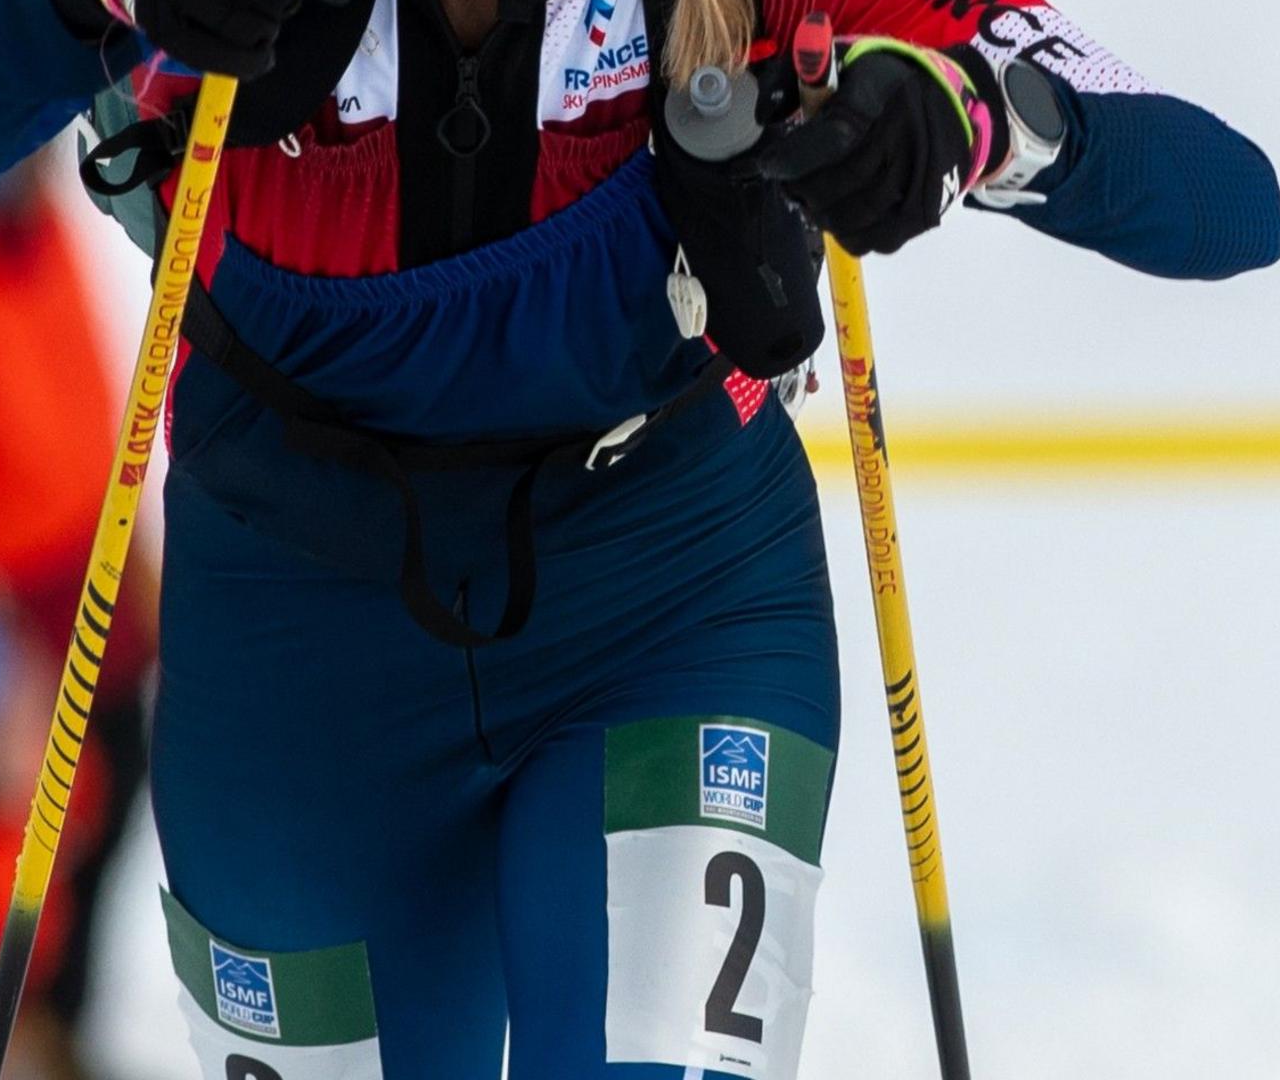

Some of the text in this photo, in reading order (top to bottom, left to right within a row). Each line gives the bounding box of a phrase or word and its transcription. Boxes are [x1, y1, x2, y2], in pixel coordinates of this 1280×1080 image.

[565, 34, 649, 90] FRNCE
[141, 282, 188, 396] CARBON
[127, 401, 162, 453] ATK
[708, 764, 761, 791] ISMF
[743, 797, 764, 813] CUP
[704, 850, 766, 1043] 2
[220, 978, 268, 1007] ISMF
